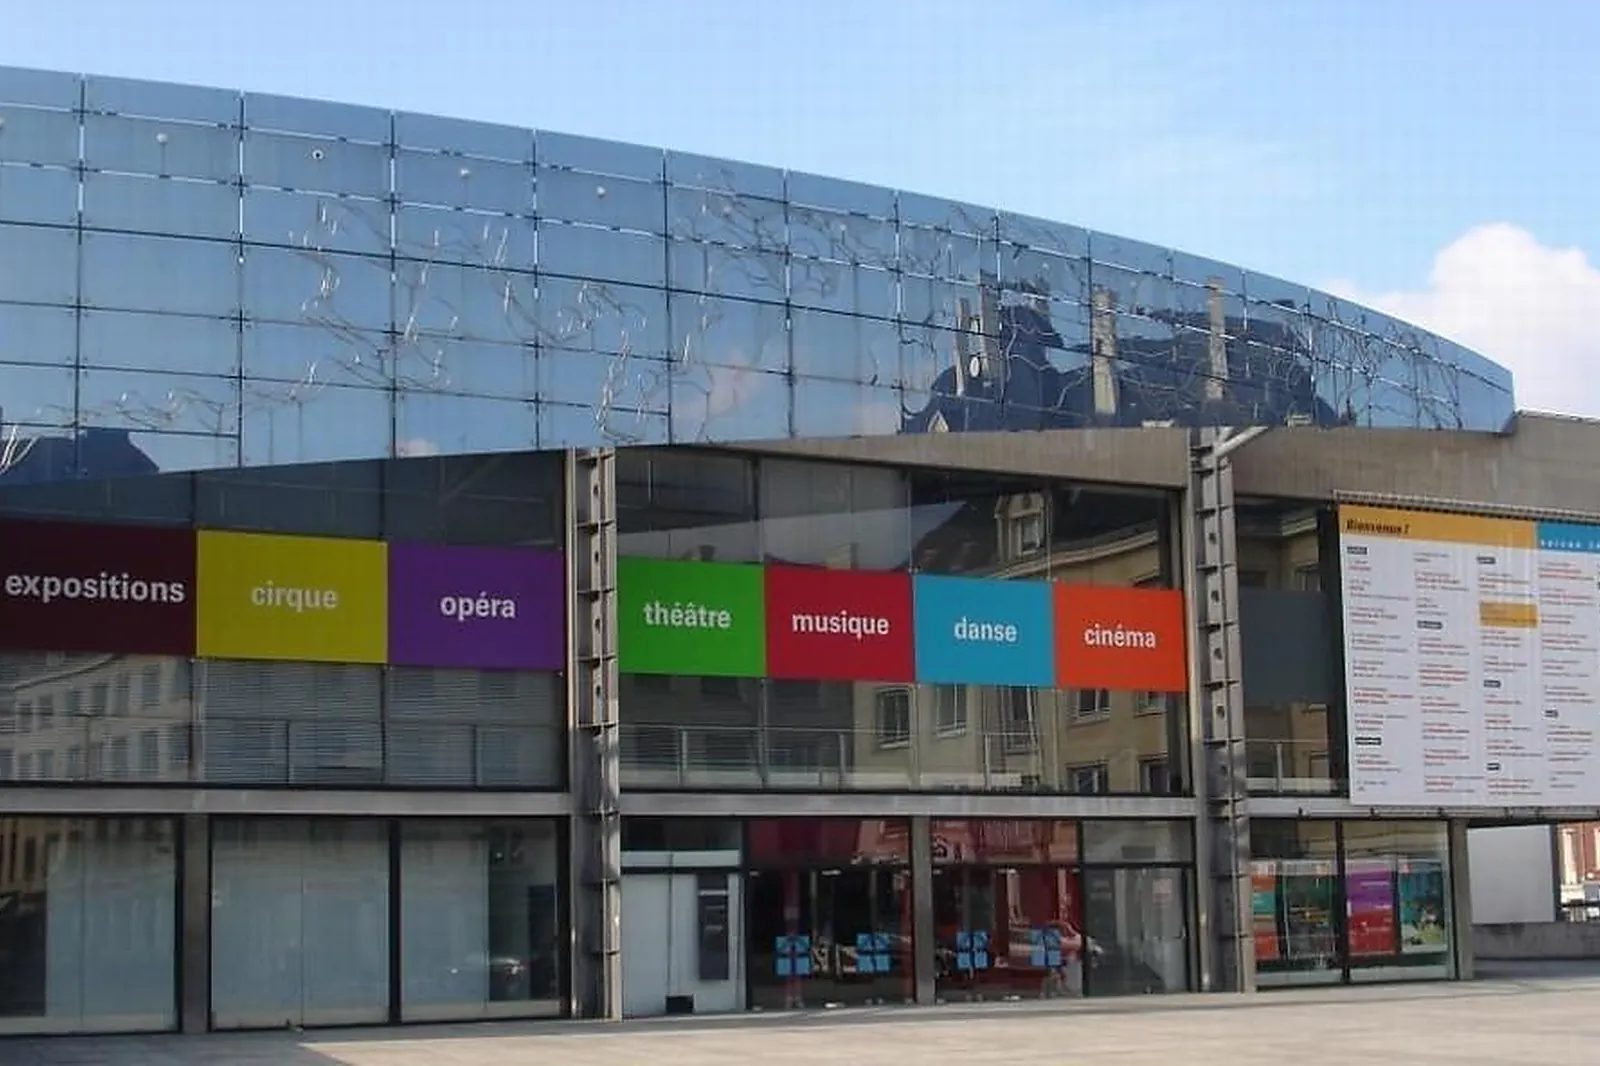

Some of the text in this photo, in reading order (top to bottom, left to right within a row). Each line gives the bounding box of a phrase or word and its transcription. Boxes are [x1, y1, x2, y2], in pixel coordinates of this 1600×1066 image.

[5, 571, 185, 605] expositions
[250, 580, 338, 612] cirque
[440, 592, 516, 622] opéra
[644, 601, 732, 629] théâtre
[791, 611, 890, 639] musique
[954, 615, 1019, 645] danse
[1083, 623, 1156, 649] cinéma
